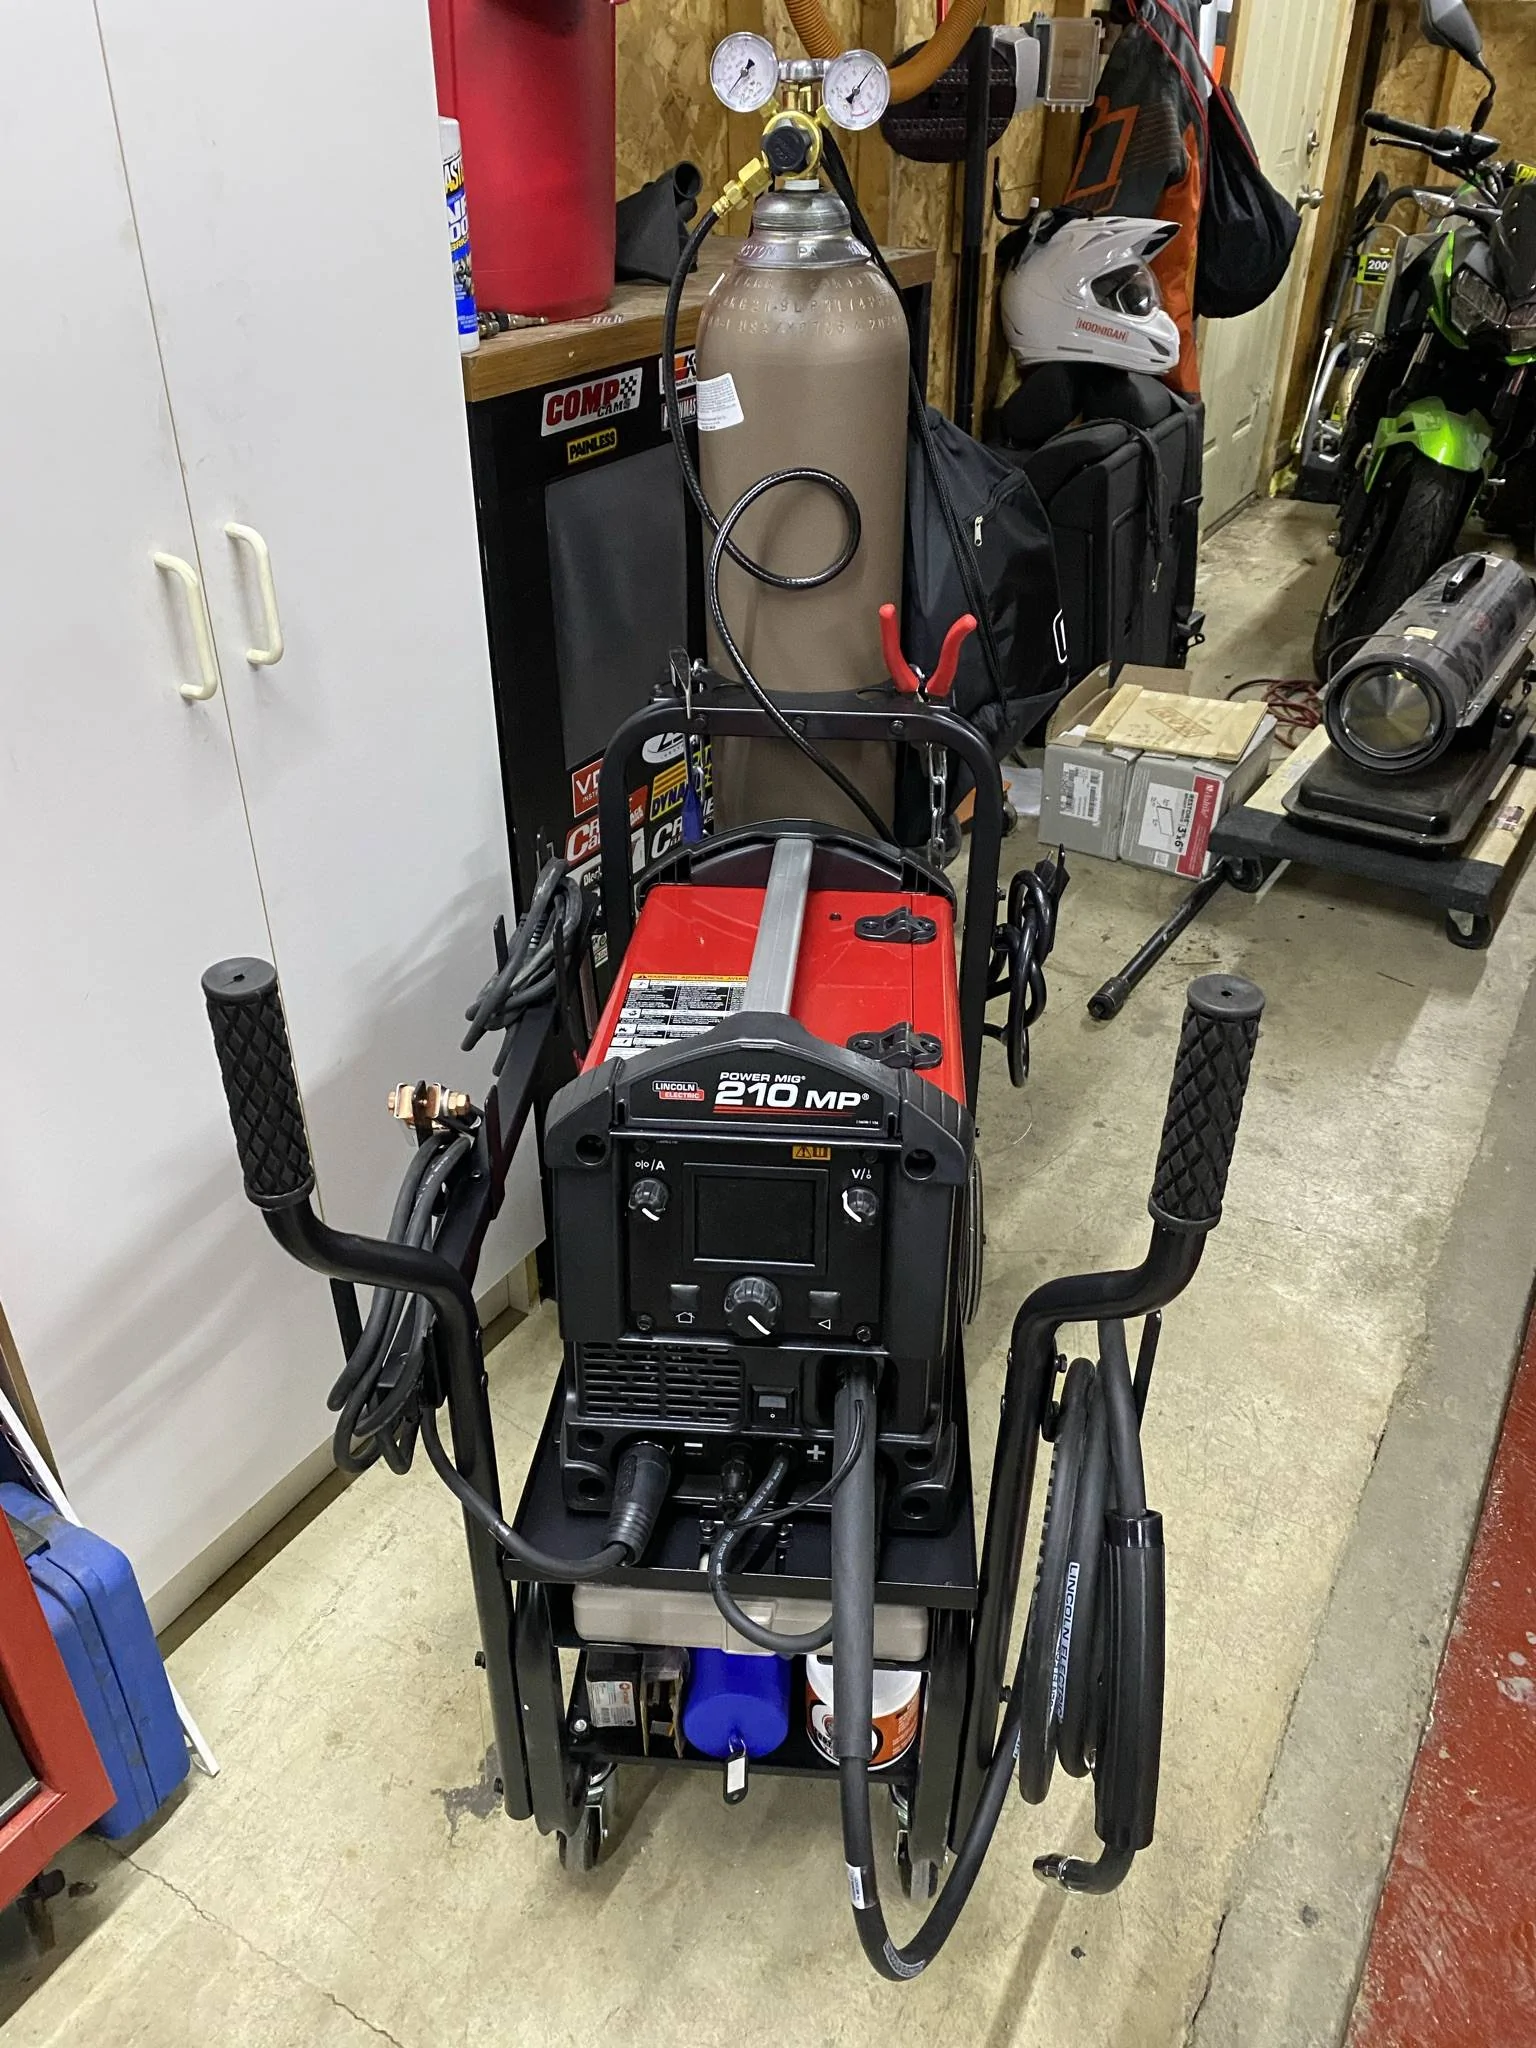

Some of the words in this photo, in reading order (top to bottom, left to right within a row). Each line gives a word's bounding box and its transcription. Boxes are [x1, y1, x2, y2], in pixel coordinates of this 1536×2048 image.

[546, 379, 621, 426] COMP
[597, 398, 631, 417] CAMS
[570, 431, 616, 460] PAINLESS
[655, 1083, 696, 1092] LINCOLN
[720, 1072, 771, 1082] POWER
[664, 1091, 700, 1099] ELECTRIC
[715, 1081, 798, 1108] 210
[1062, 1563, 1080, 1641] LINCOLN
